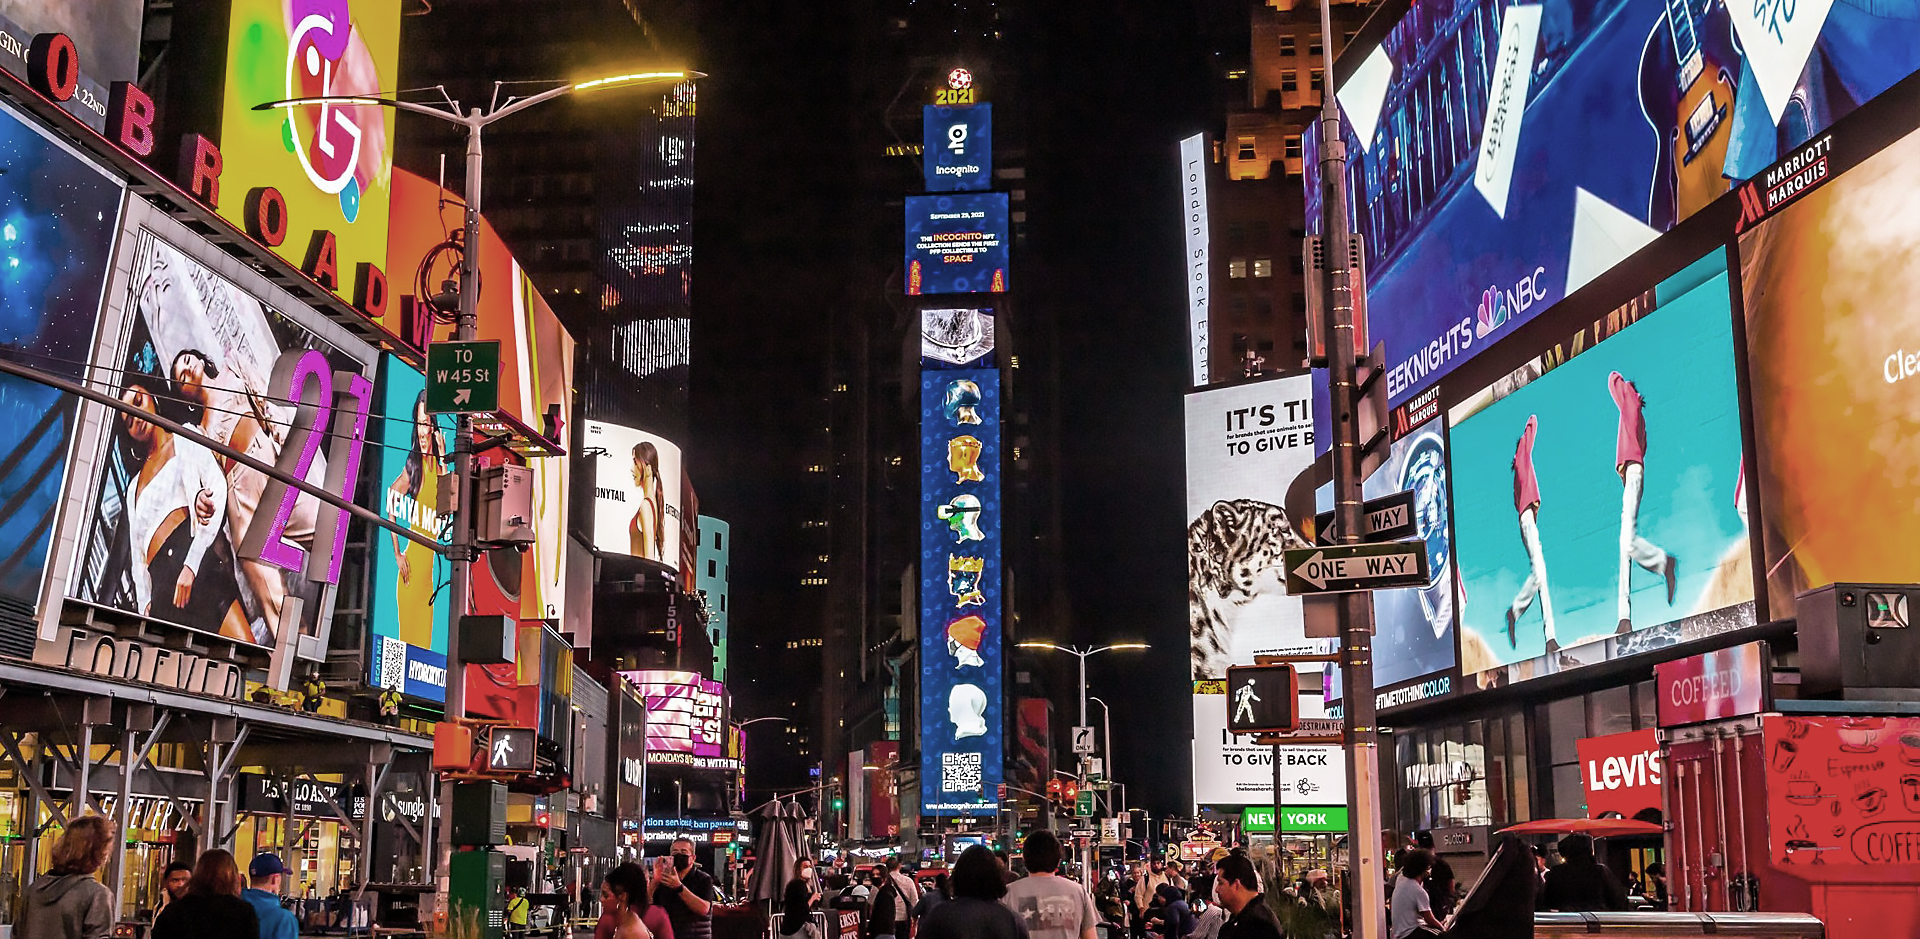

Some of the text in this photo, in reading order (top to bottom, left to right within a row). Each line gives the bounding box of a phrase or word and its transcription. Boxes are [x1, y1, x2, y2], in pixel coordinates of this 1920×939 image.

[81, 89, 106, 117] 22ND
[936, 89, 974, 105] 2021
[1767, 135, 1832, 188] MARRIOTT
[1769, 161, 1826, 207] MARQUIS
[1188, 160, 1202, 236] London
[934, 232, 982, 241] INCOGNITO
[1194, 249, 1205, 307] Stock
[1506, 266, 1547, 321] NBC
[455, 350, 473, 364] TO
[437, 369, 490, 384] W 45 St
[1409, 386, 1440, 413] MARRIOTT
[1226, 399, 1308, 431] IT'S TI
[1410, 404, 1437, 426] MARQUIS
[1227, 441, 1250, 456] TO
[1256, 433, 1297, 452] GIVE
[386, 487, 419, 526] KENYA
[1371, 508, 1401, 531] WAY
[1308, 556, 1408, 579] ONE WAY
[666, 594, 677, 641] 1500
[1376, 677, 1450, 710] #TIMETOTHINKCOLOR
[1672, 670, 1741, 707] COFFEED
[1300, 722, 1329, 730] DESTRIAN
[648, 752, 684, 763] MONDAYS
[707, 759, 728, 768] WITH
[1222, 754, 1243, 765] TO
[1287, 754, 1327, 765] BACK
[1827, 757, 1884, 779] Espresso
[398, 796, 424, 823] sungla
[1287, 813, 1327, 825] YORK
[694, 820, 708, 829] ban
